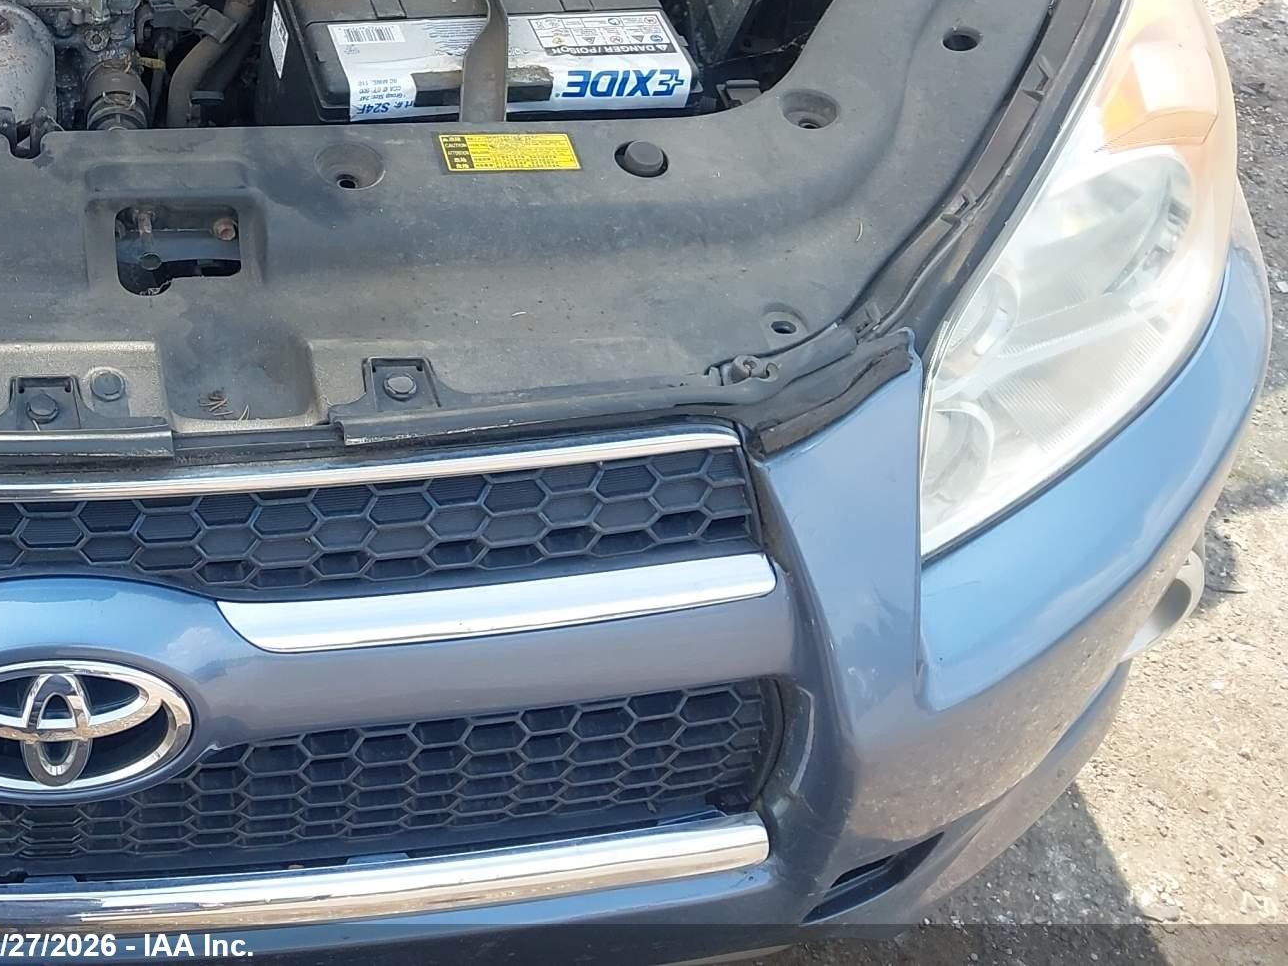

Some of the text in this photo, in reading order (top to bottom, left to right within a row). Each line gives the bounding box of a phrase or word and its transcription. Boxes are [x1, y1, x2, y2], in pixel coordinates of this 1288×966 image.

[550, 45, 597, 55] POISON
[604, 44, 658, 54] DANGER
[562, 69, 685, 98] EXIDE
[357, 102, 391, 115] S24F
